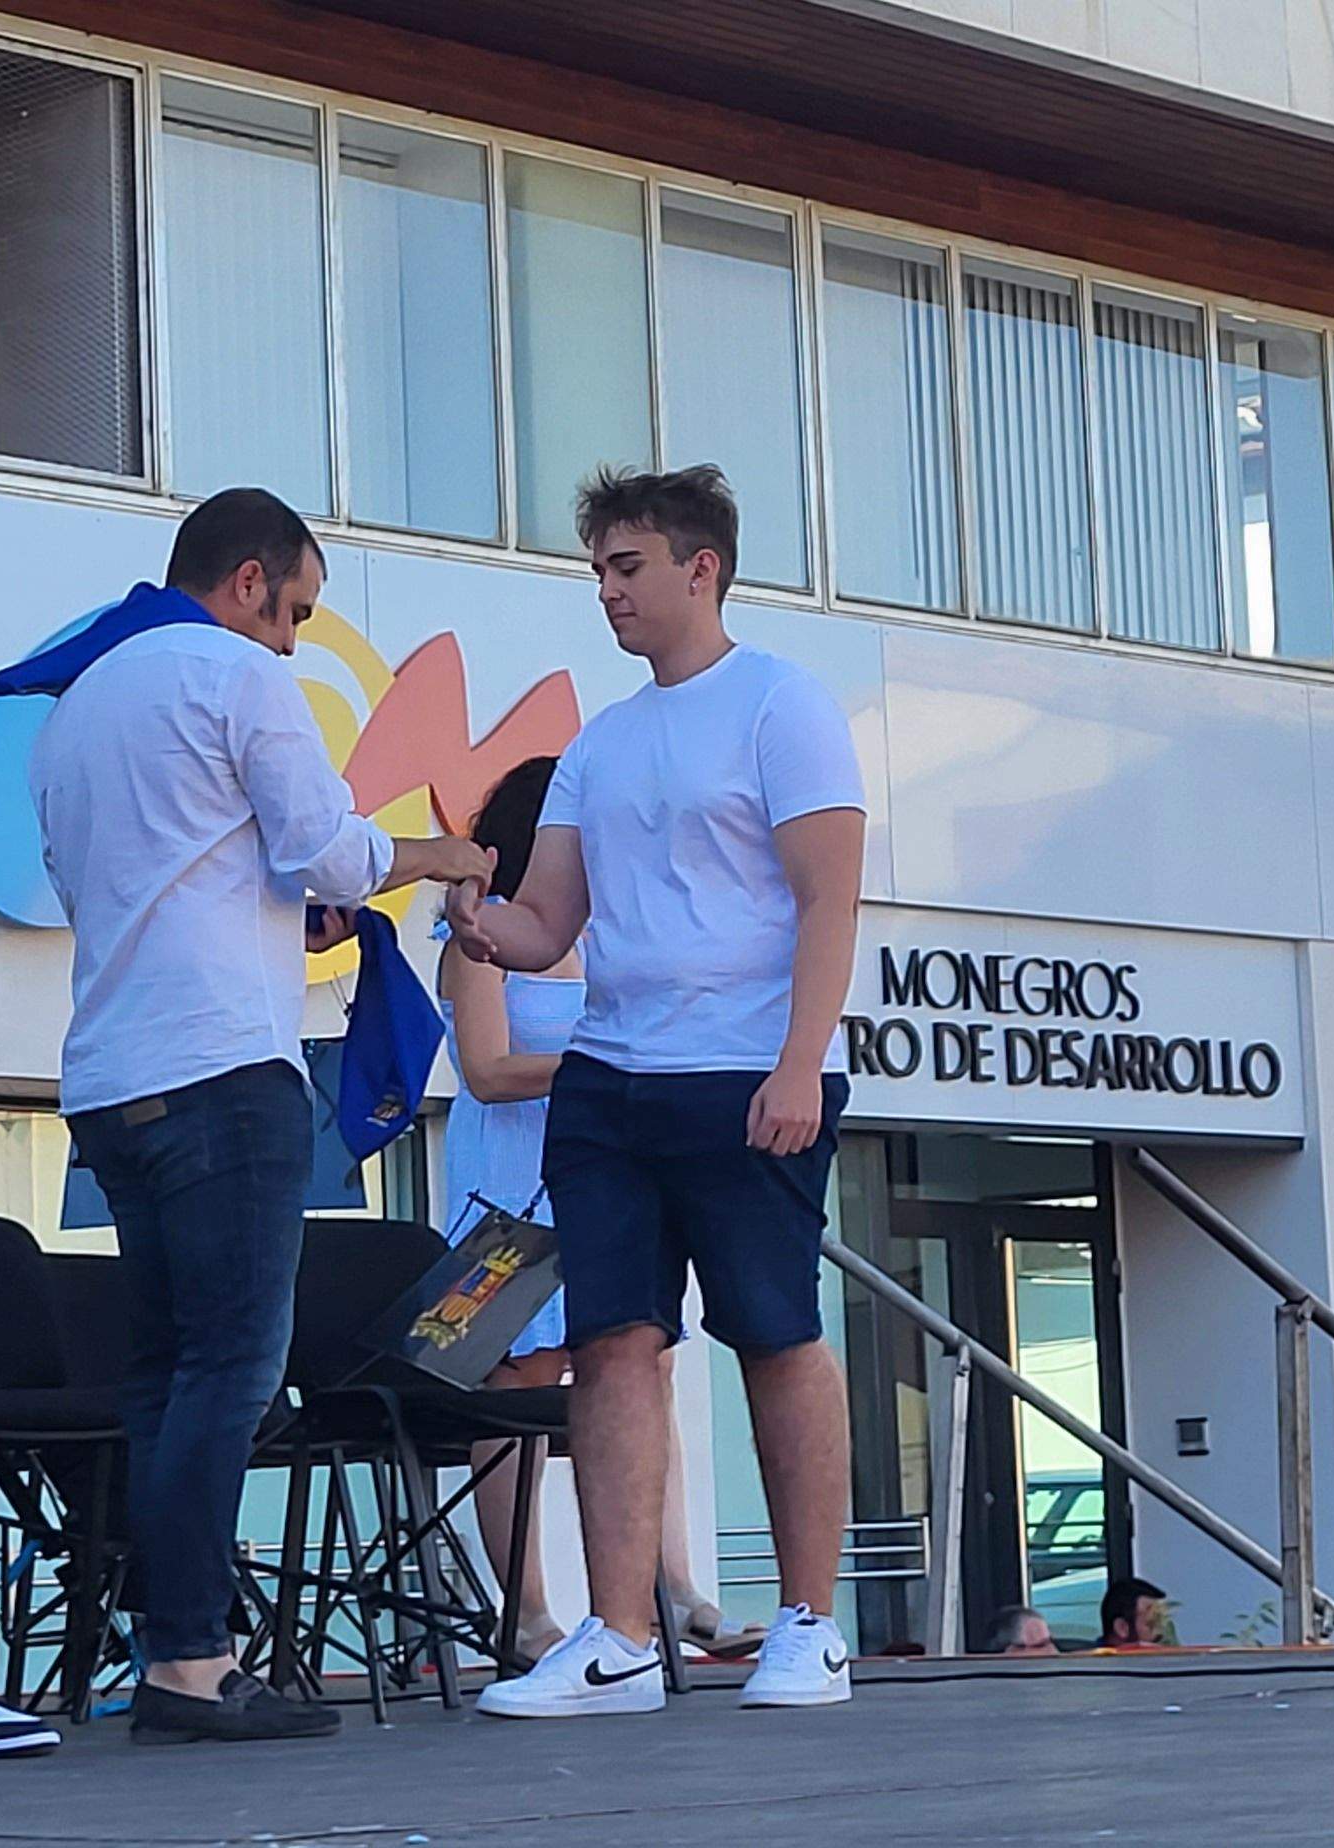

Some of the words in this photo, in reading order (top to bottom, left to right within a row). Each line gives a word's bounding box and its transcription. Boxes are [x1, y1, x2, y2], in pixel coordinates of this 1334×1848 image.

[880, 946, 1140, 1021] MONEGROS
[932, 1021, 996, 1083] DE
[1004, 1027, 1281, 1098] DESARROLLO
